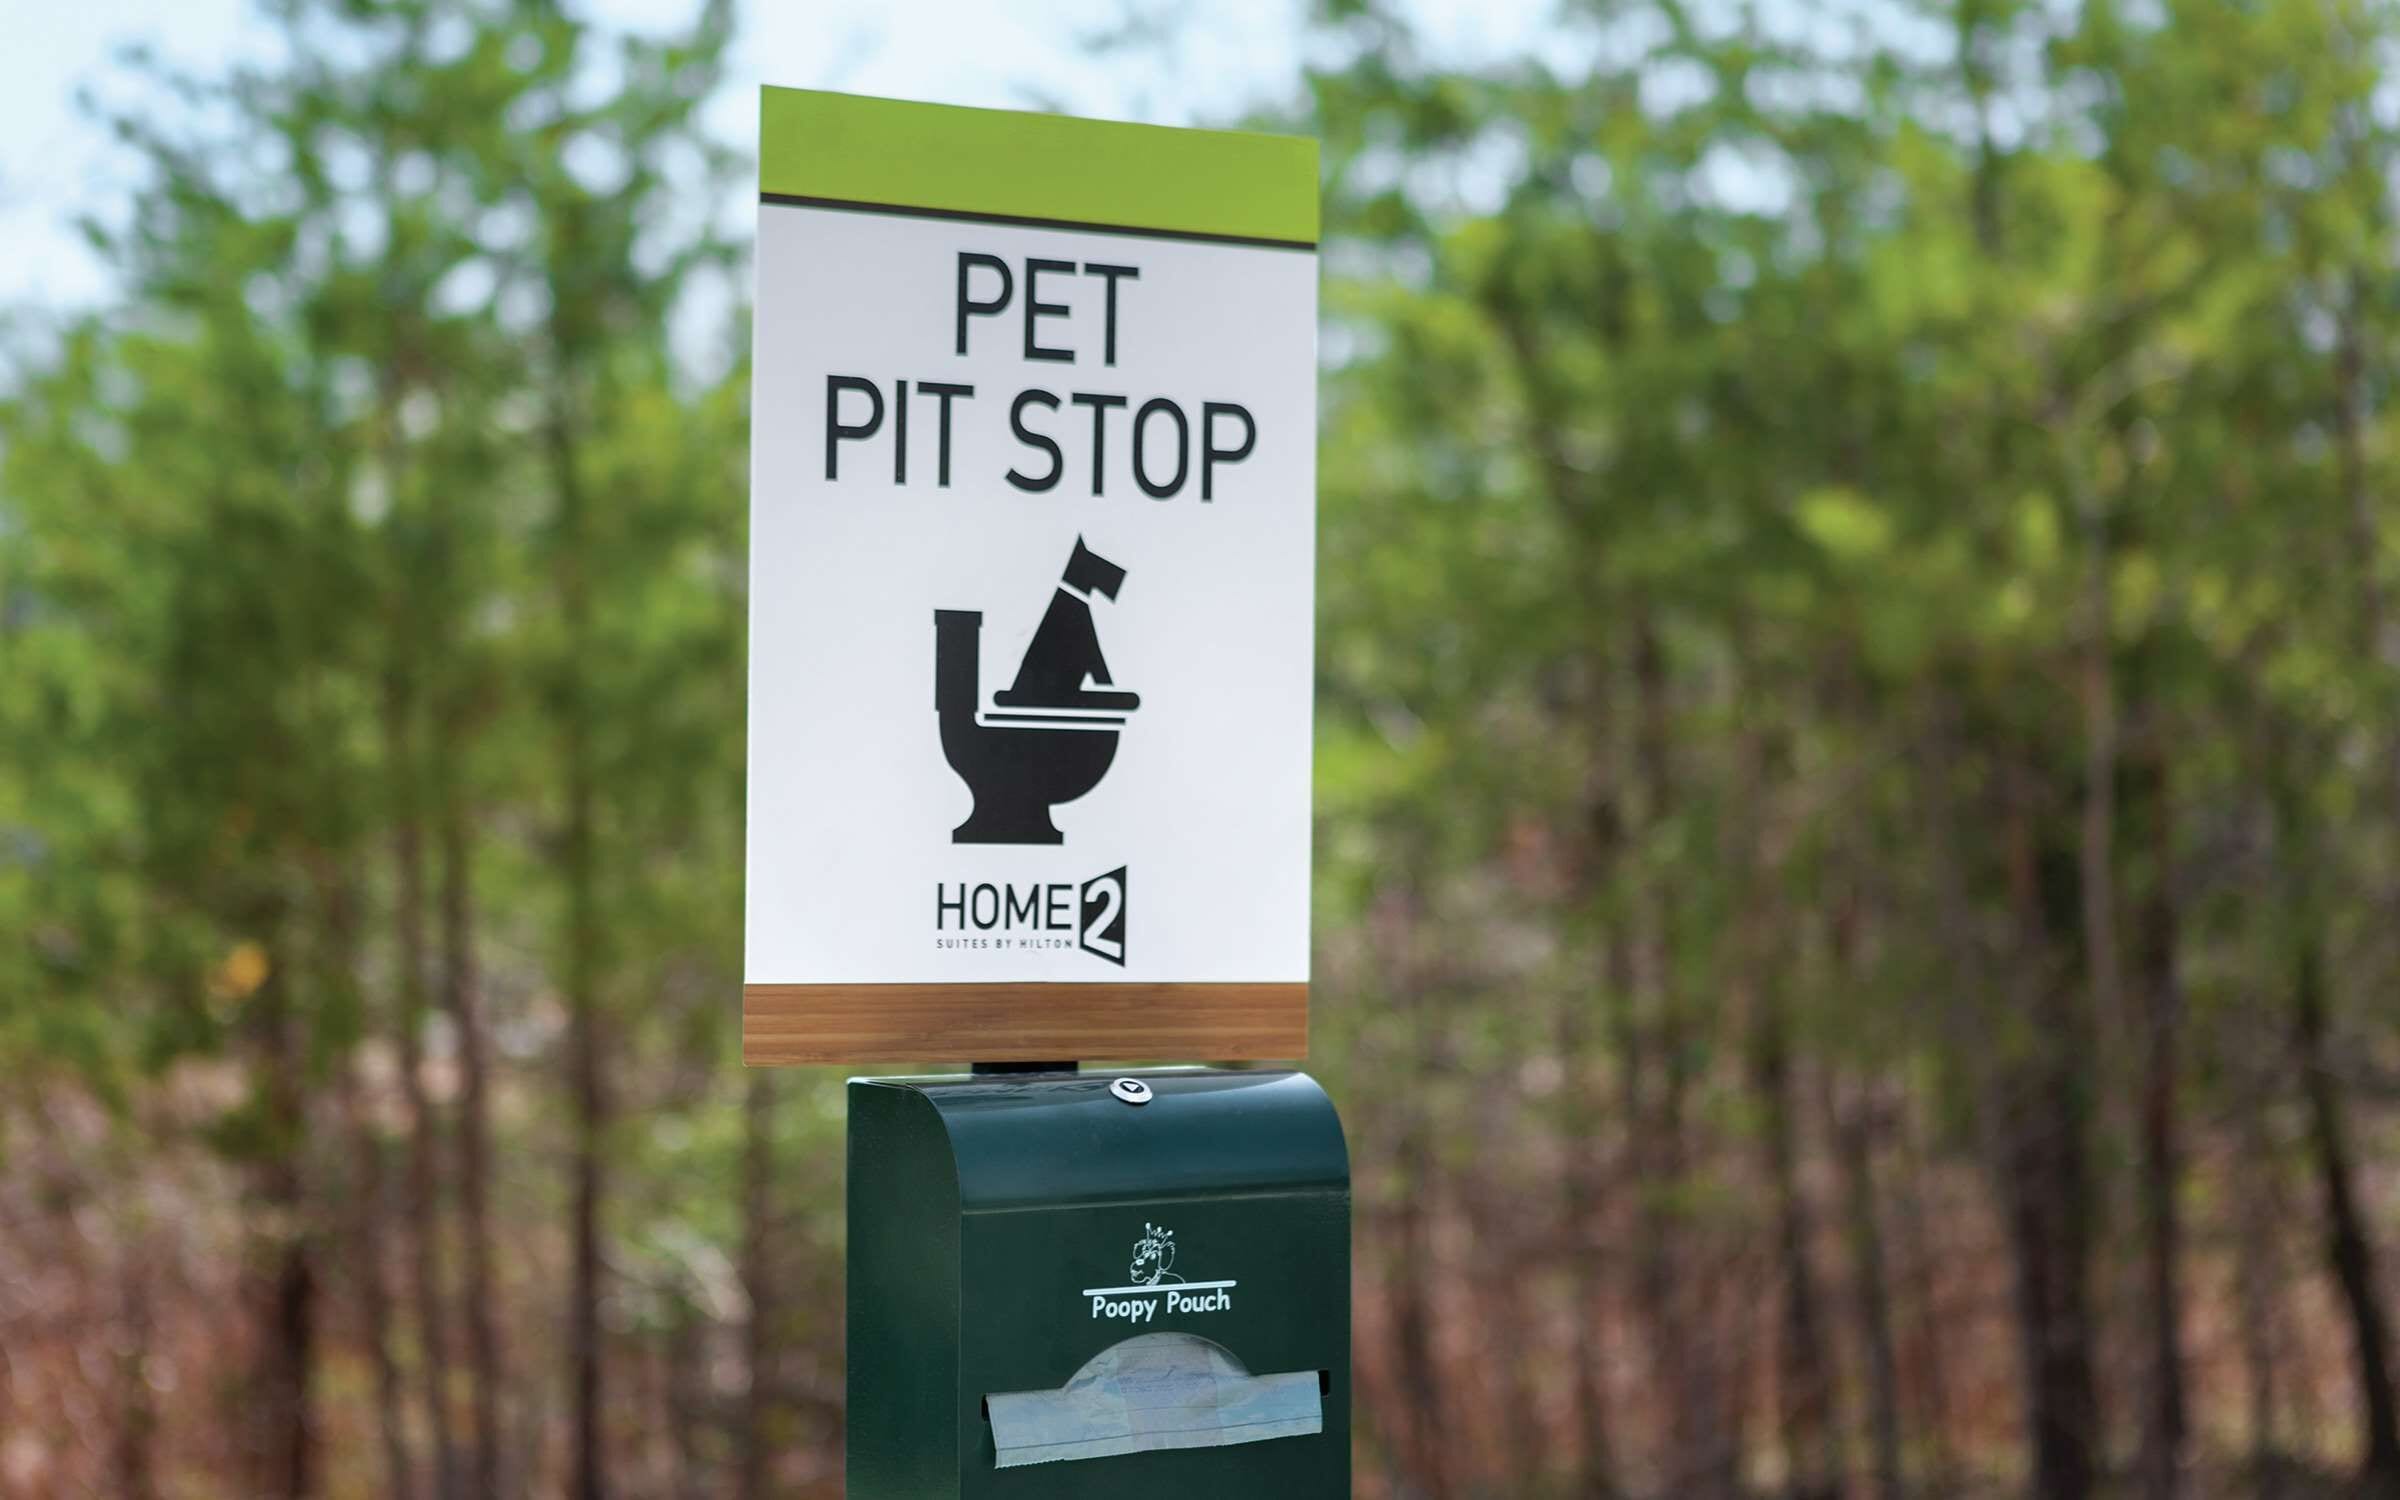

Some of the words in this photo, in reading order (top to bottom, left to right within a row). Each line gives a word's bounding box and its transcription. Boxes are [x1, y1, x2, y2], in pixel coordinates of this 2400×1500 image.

[956, 251, 1140, 366] PET
[825, 374, 975, 488] PIT
[1004, 388, 1257, 502] STOP
[937, 882, 1073, 930] HOME
[936, 939, 988, 949] SUITES
[996, 939, 1012, 949] BY
[1020, 939, 1073, 949] HILTON
[1092, 1295, 1158, 1323] Poopy
[1166, 1288, 1231, 1313] Pouch
